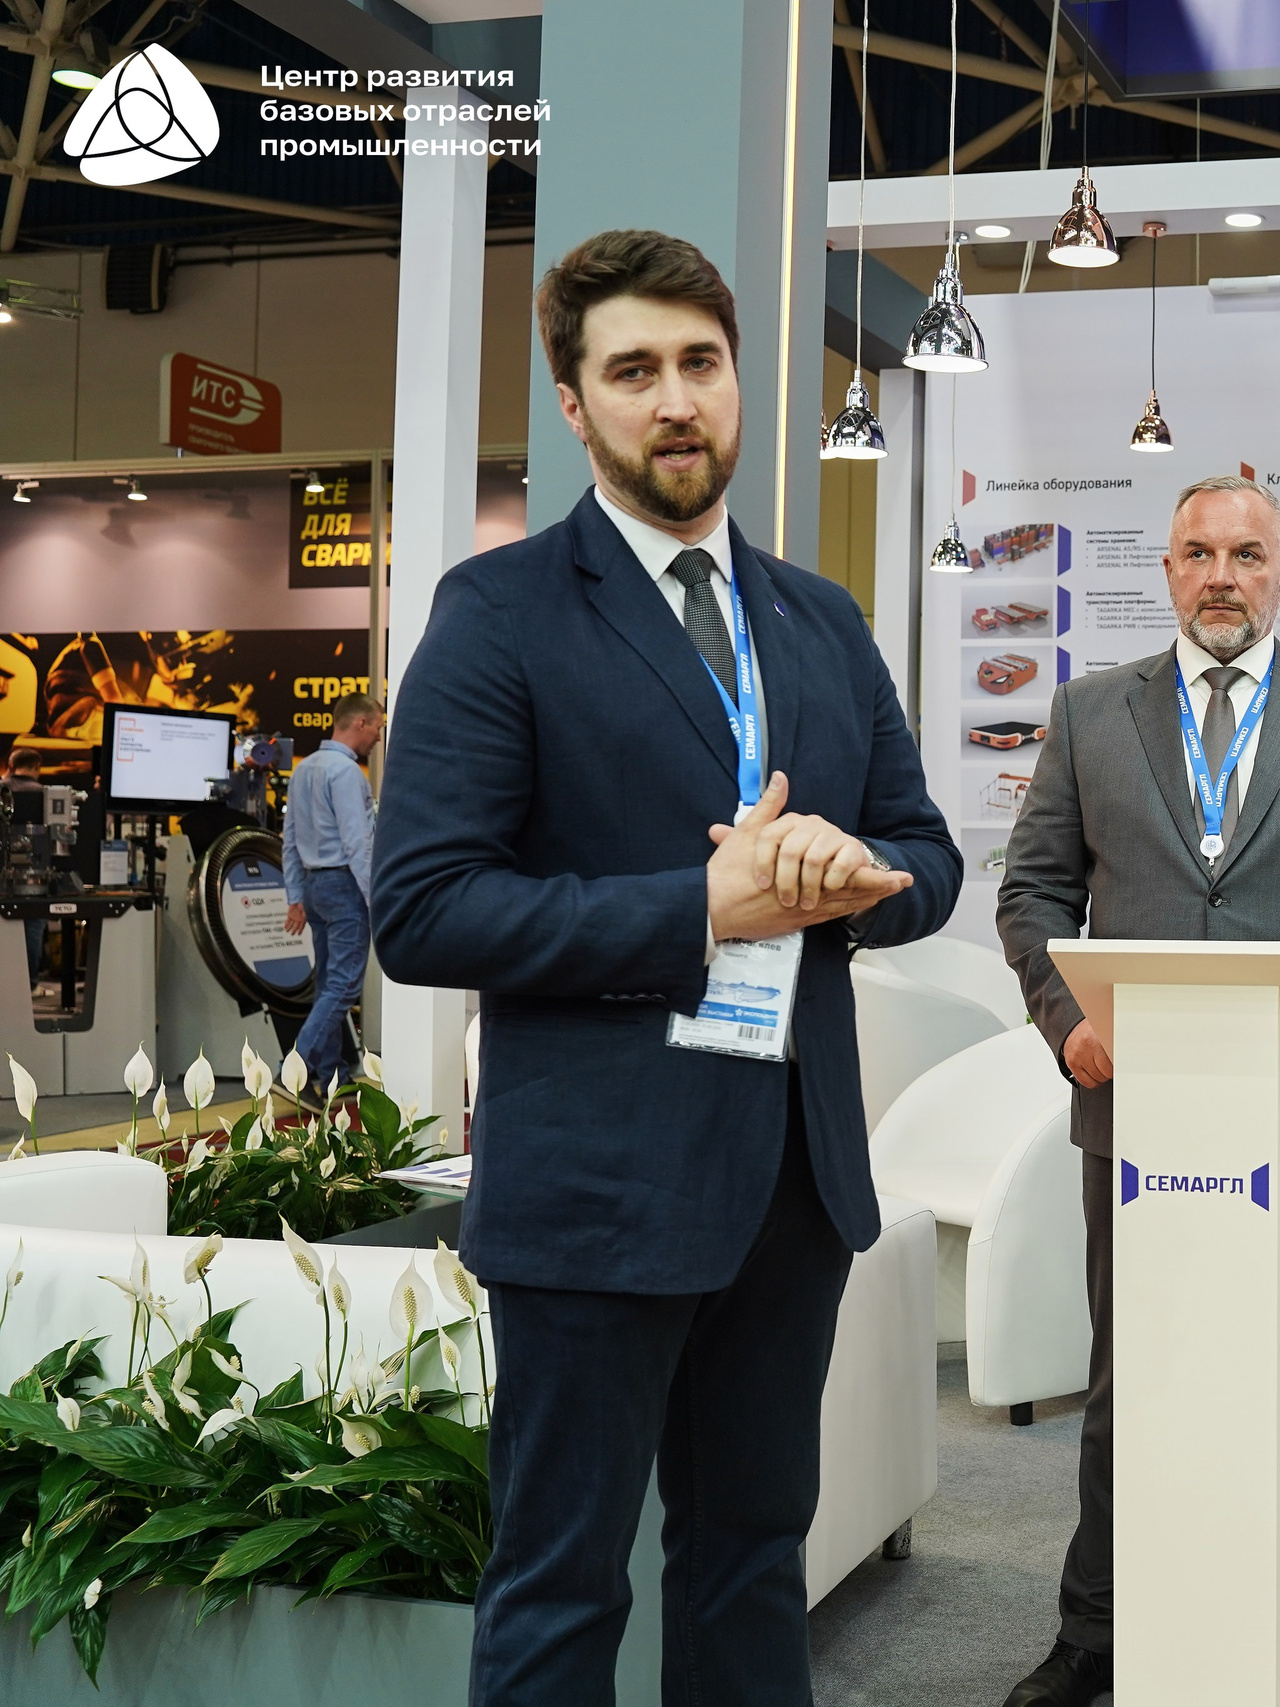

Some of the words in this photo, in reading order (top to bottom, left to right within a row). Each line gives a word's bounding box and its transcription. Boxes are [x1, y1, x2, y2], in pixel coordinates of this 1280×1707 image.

[191, 375, 236, 408] ИТС
[303, 478, 349, 506] ВСЁ
[986, 479, 1039, 492] Линейка
[1043, 478, 1132, 492] оборудования
[300, 513, 352, 540] ДЛЯ
[736, 595, 747, 634] СЕМАРГЛ
[740, 653, 752, 694] СЕМАРГЛ
[294, 677, 387, 705] страт
[1251, 687, 1269, 714] СЕМАРГЛ
[745, 714, 757, 760] СЕМАРГЛ
[1187, 728, 1201, 758] СЕМАРГЛ
[1230, 727, 1249, 757] СЕМАРГЛ
[1199, 773, 1213, 805] СЕМАРГЛ
[1216, 771, 1228, 808] СЕМАРГЛ
[1145, 1175, 1244, 1194] СЕМАРГЛ
